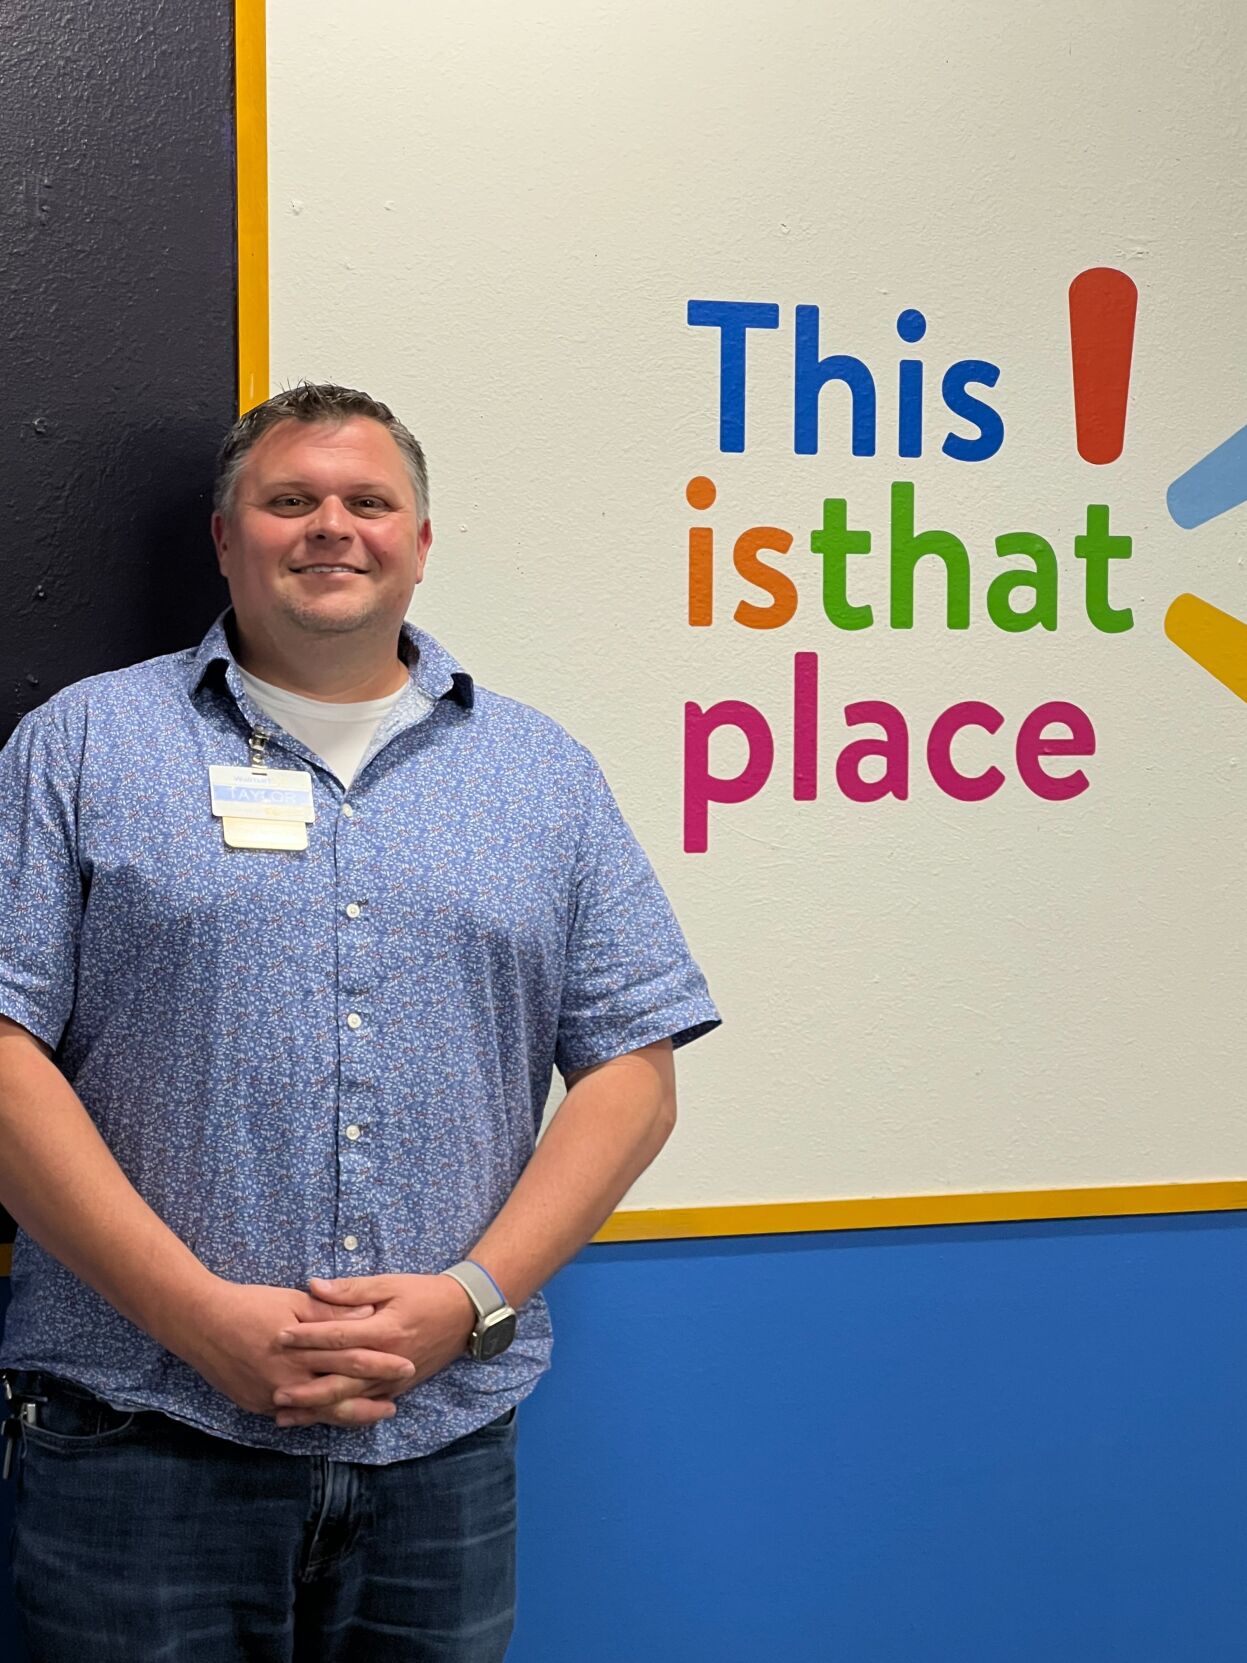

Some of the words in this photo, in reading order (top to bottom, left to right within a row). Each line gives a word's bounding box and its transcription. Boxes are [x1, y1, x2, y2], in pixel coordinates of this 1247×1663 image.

[688, 300, 1004, 462] This
[231, 786, 298, 804] TAYLOR
[684, 651, 1096, 853] place
